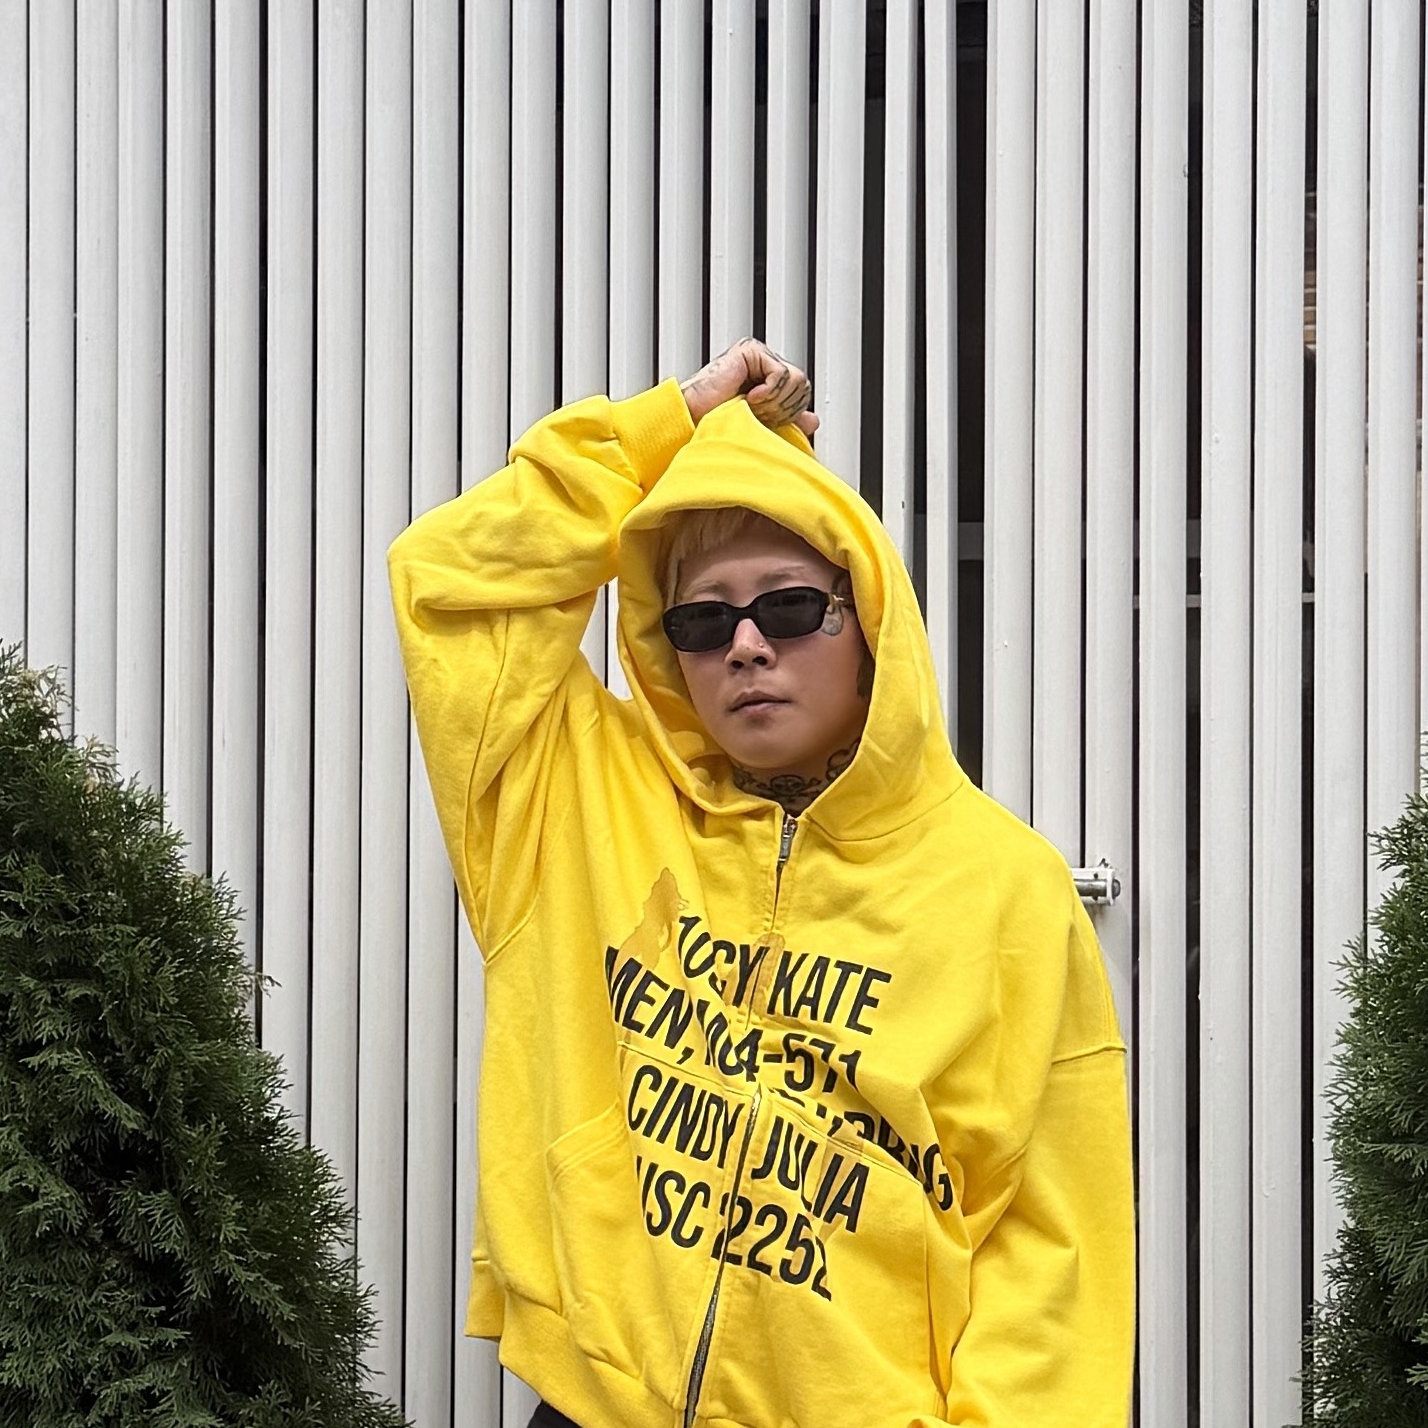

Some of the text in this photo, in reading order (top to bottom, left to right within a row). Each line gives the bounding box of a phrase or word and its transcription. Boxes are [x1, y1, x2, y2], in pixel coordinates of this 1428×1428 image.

[766, 950, 893, 1035] KATE
[628, 1064, 746, 1169] CINDY
[751, 1115, 870, 1234] JULIA
